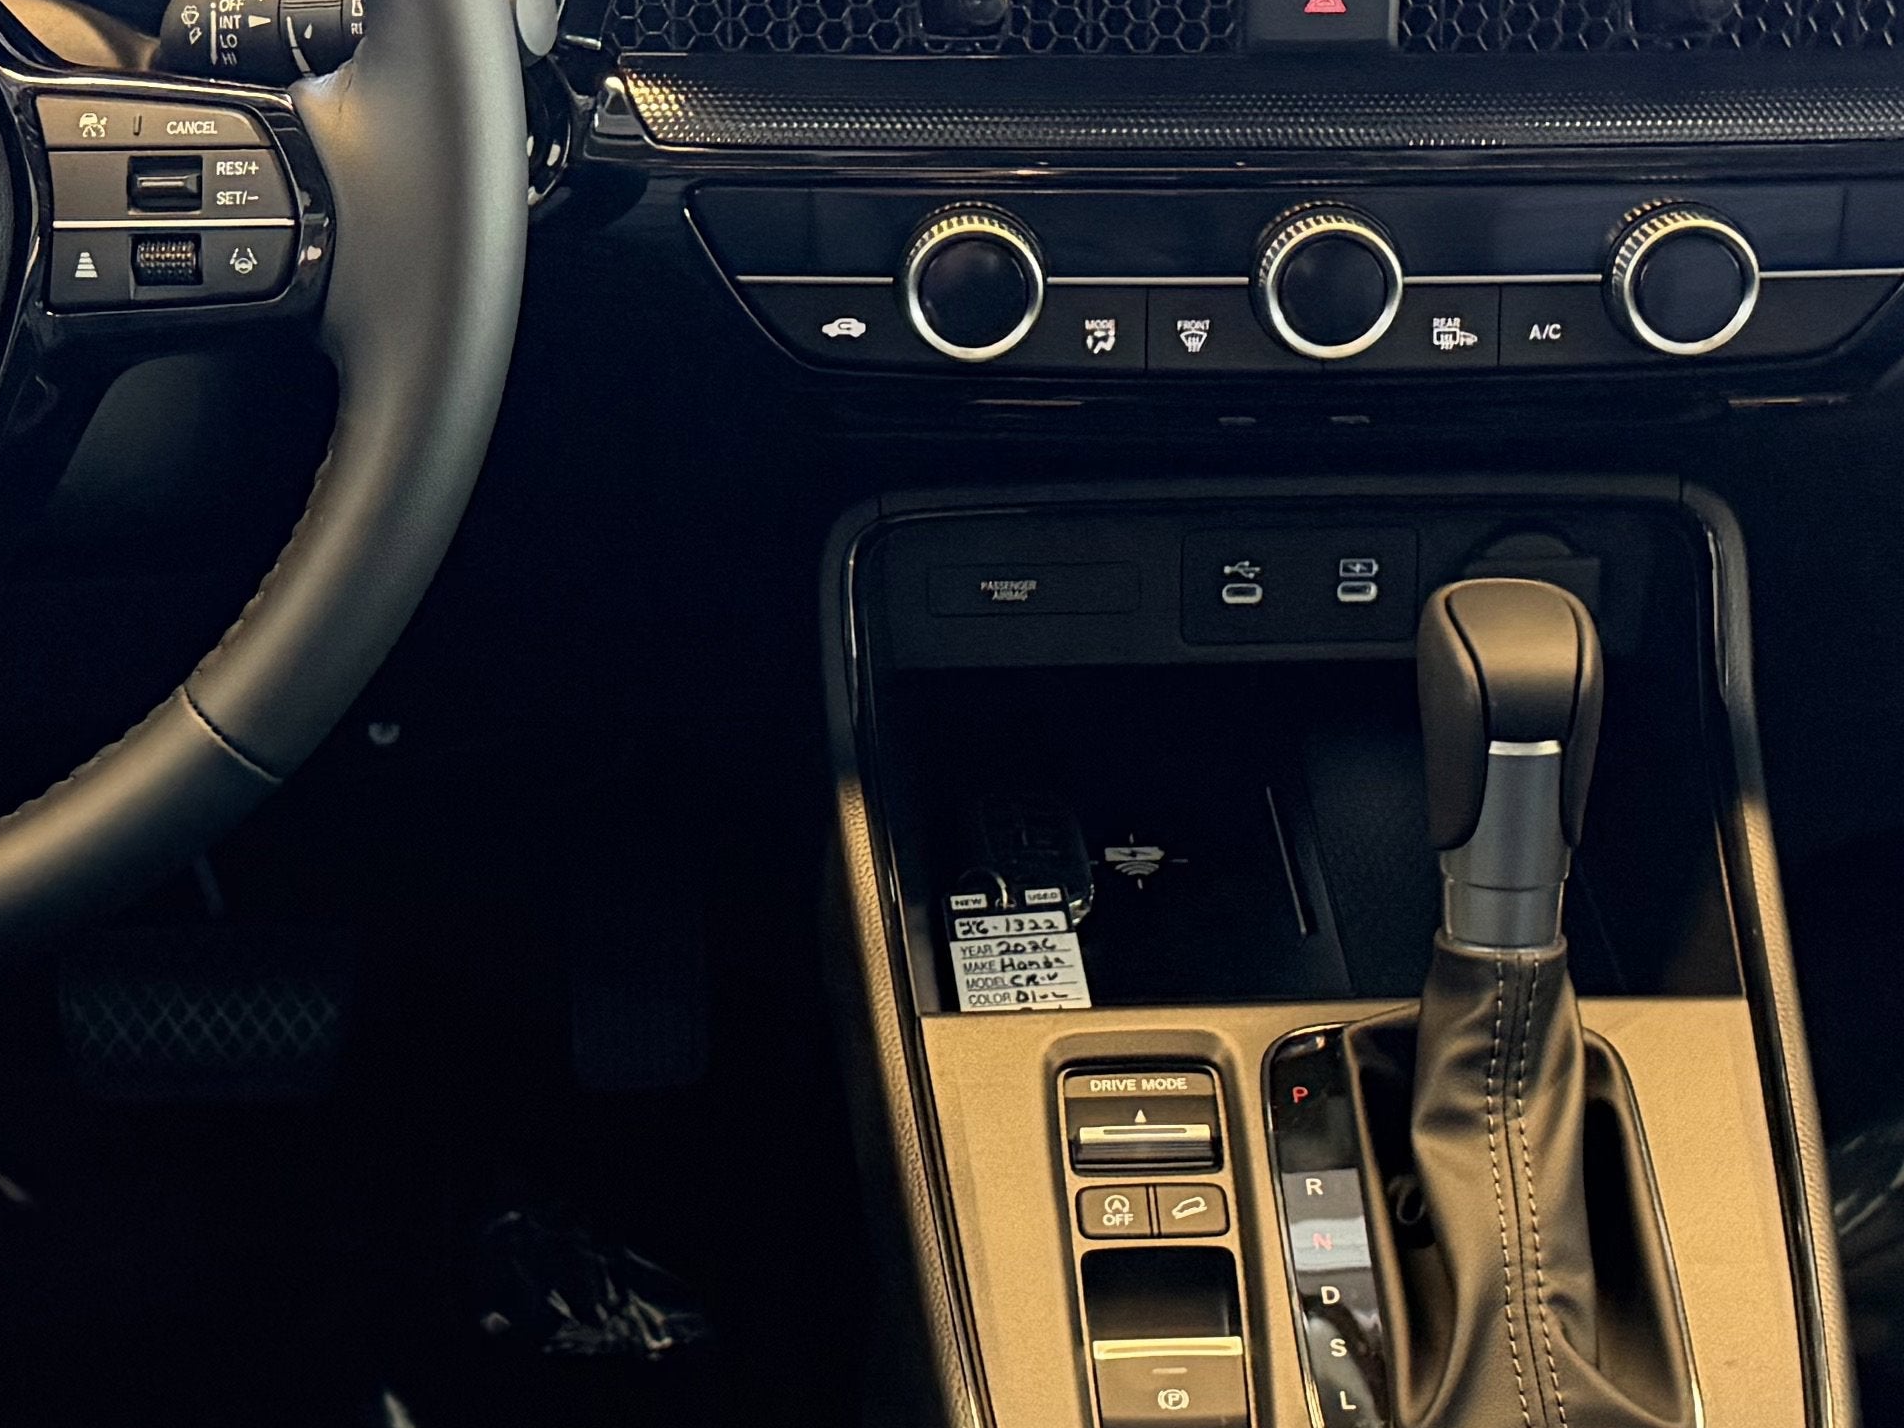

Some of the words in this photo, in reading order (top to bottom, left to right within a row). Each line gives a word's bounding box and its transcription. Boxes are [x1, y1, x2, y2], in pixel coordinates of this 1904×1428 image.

[219, 15, 242, 30] INT
[219, 33, 238, 49] LO
[221, 52, 238, 66] HI
[166, 120, 218, 134] CANCEL
[216, 161, 259, 175] RES/+
[216, 190, 259, 205] SET/-
[1177, 320, 1210, 331] FRONT
[1433, 317, 1461, 328] REAR
[1529, 324, 1562, 340] A/C
[954, 898, 983, 906] NEW
[960, 945, 993, 956] YEAR
[963, 960, 996, 972] MAKE
[966, 975, 1008, 989] MODEL
[968, 992, 1012, 1006] COLOR
[1090, 1079, 1137, 1091] DRIVE
[1141, 1077, 1188, 1090] MODE
[1292, 1086, 1308, 1103] P
[1305, 1178, 1324, 1196] R
[1102, 1213, 1134, 1226] OFF
[1312, 1233, 1333, 1250] N
[1320, 1285, 1341, 1305] D
[1330, 1338, 1347, 1357] S
[1339, 1390, 1357, 1410] L
